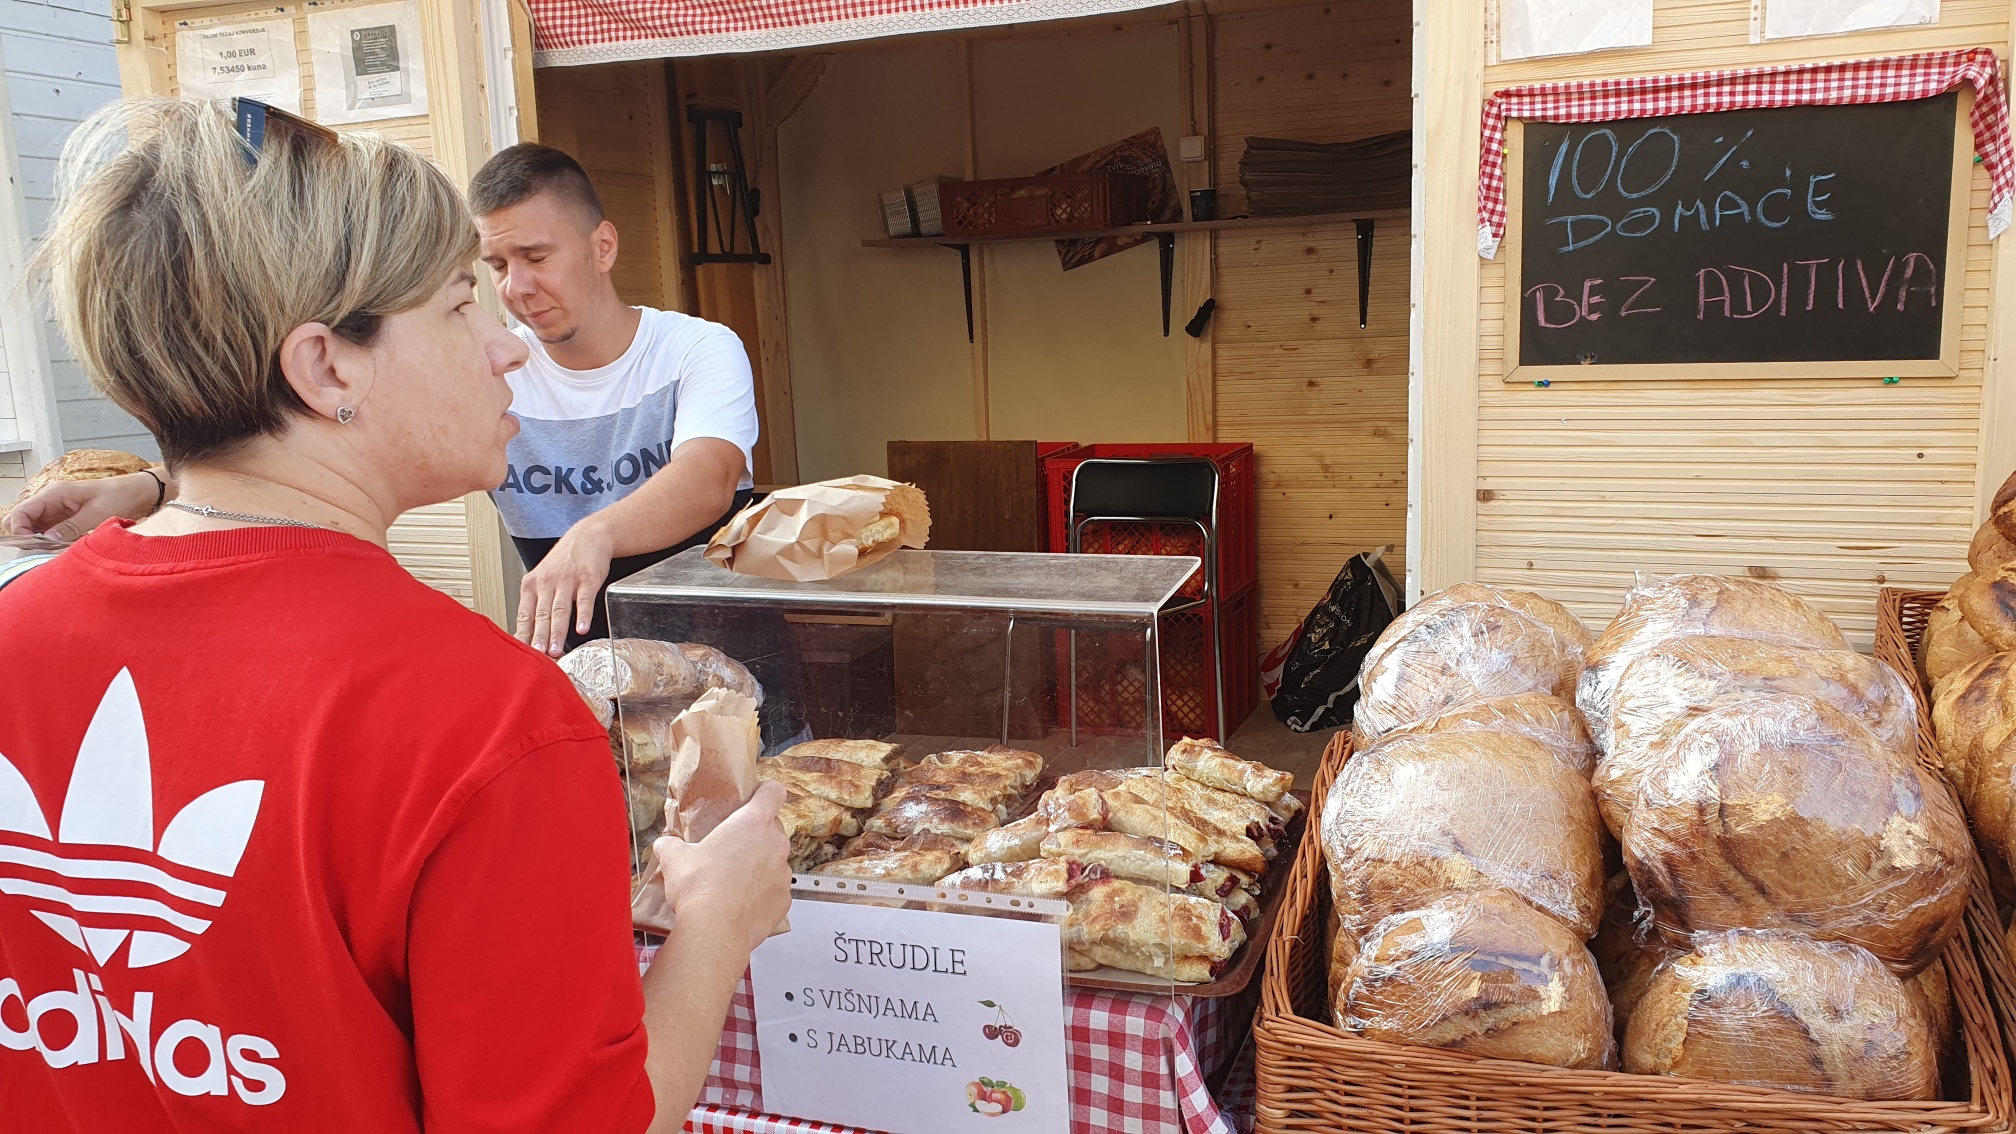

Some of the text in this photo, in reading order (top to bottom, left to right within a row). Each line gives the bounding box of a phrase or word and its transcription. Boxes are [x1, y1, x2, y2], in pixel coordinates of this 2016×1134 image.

[211, 63, 267, 76] 7,53450 kuna
[219, 48, 256, 60] 1,00 EUR
[245, 113, 253, 143] AWKERS
[1128, 159, 1162, 175] rgovinu
[1547, 125, 1755, 206] 100 %
[1525, 252, 1937, 330] BEZ ADITIVA
[499, 439, 673, 496] ACK&JON
[833, 931, 968, 976] ŠTRUDLE
[803, 987, 940, 1023] S VIŠNJAMA
[806, 1029, 958, 1068] S JABUKAMA
